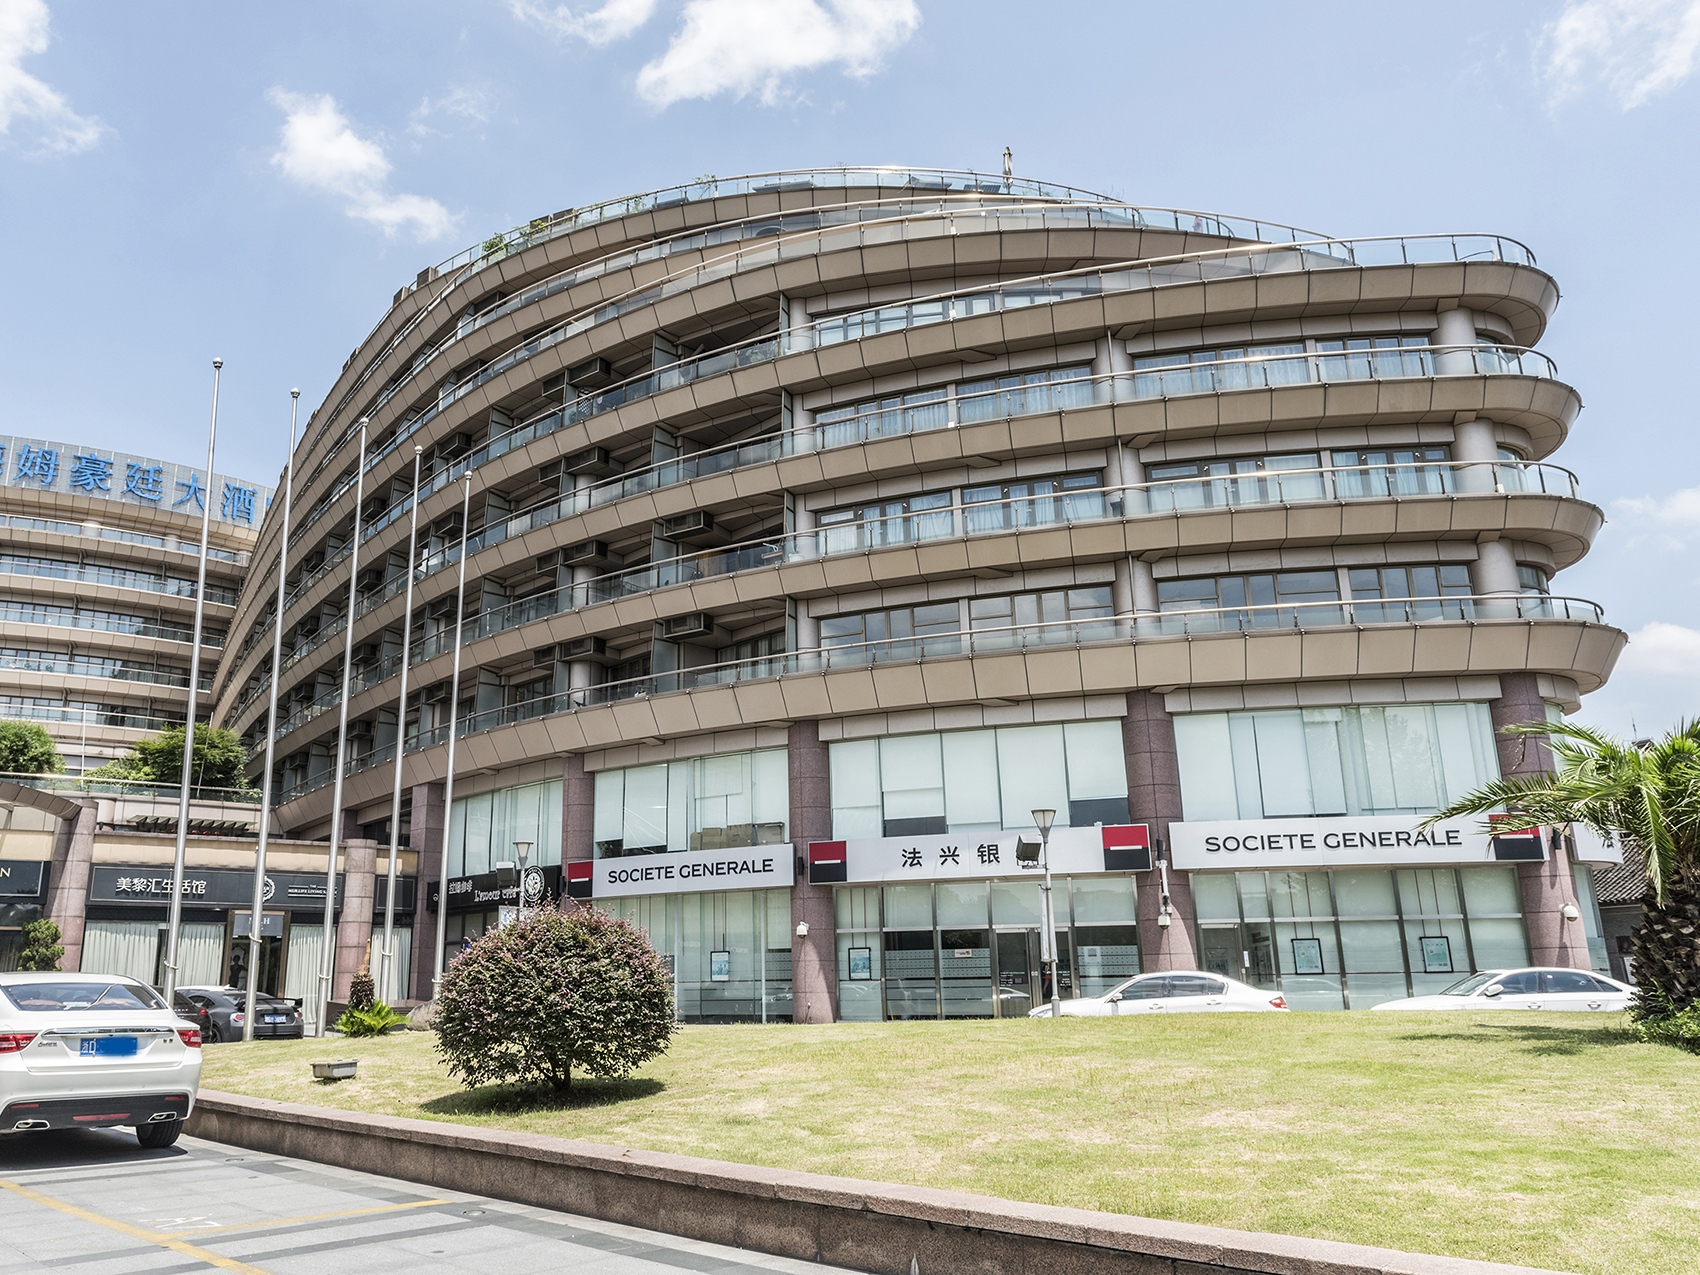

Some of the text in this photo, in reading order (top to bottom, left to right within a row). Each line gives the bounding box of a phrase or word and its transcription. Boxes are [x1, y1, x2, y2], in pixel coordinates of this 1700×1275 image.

[0, 443, 273, 523] 姆豪廷大酒
[1205, 830, 1463, 851] SOCIETE GENERALE
[901, 844, 1001, 868] 法兴银
[608, 858, 774, 884] SOCIETE GENERALE
